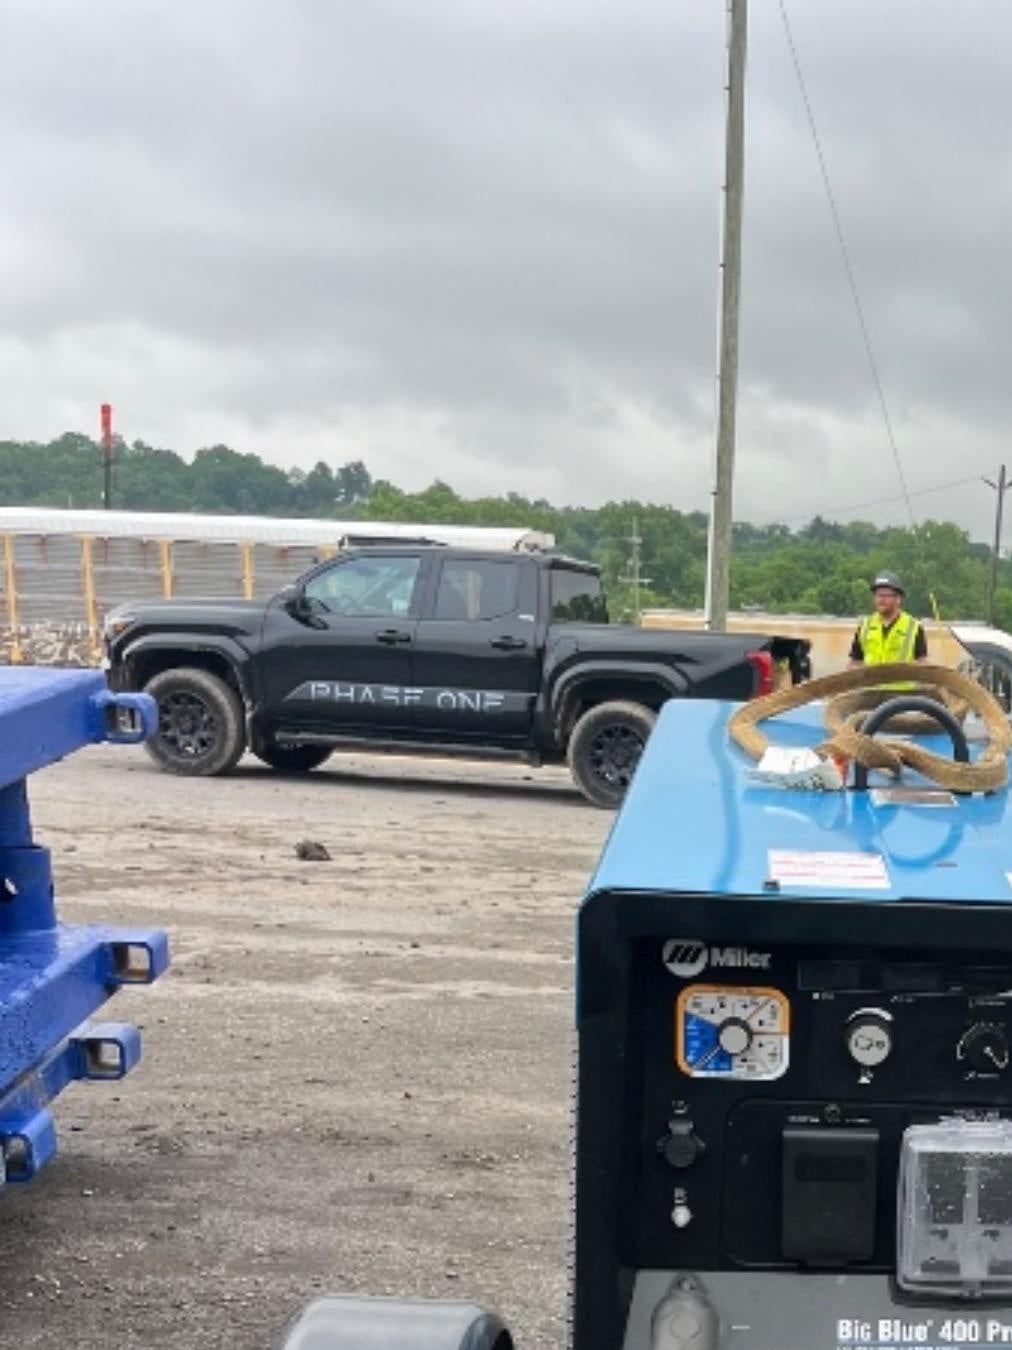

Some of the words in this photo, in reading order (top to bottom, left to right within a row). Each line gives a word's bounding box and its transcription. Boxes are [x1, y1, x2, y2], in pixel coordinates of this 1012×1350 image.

[310, 683, 424, 705] PHASE
[437, 689, 505, 711] ONE
[709, 946, 772, 970] Miller
[938, 1319, 980, 1343] 400
